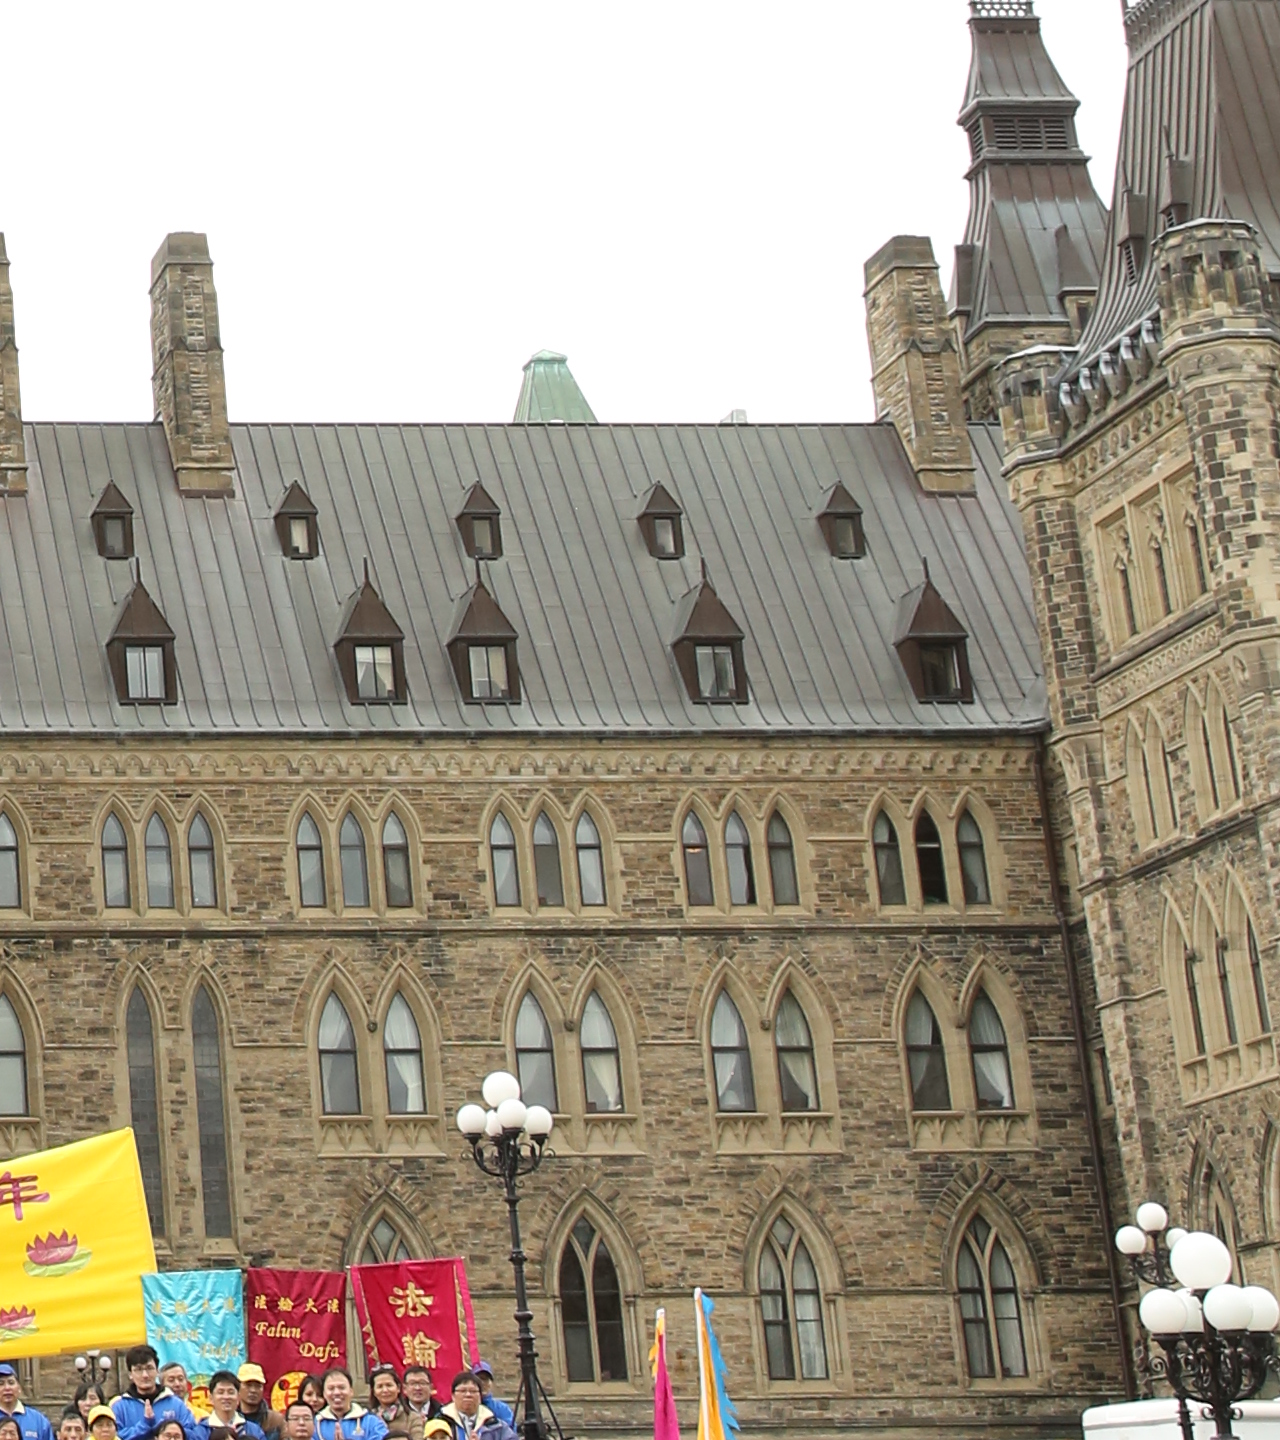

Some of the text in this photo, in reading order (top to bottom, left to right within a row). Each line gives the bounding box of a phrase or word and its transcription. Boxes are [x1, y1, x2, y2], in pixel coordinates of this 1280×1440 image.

[155, 1324, 199, 1342] Falun
[255, 1320, 301, 1338] Falun
[201, 1339, 239, 1362] Dafa
[299, 1341, 340, 1363] Dafa
